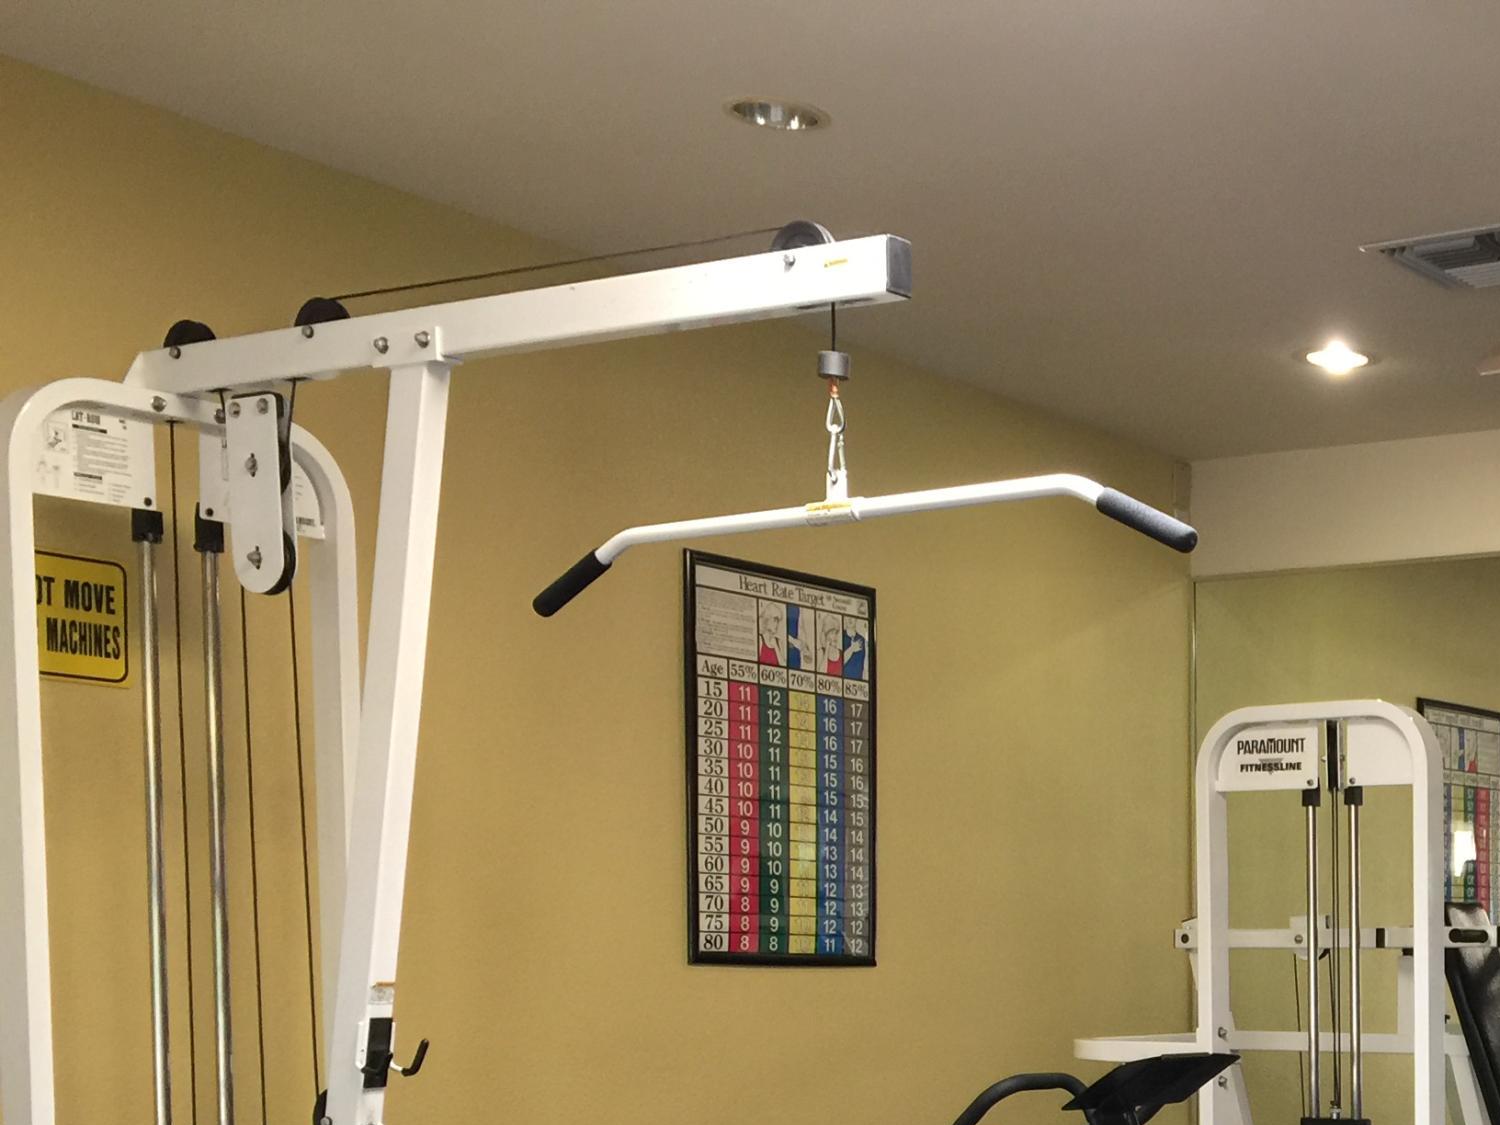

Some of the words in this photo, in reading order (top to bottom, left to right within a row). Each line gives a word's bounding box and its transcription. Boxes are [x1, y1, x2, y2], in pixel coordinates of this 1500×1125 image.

[64, 579, 116, 615] MOVE
[739, 575, 767, 595] Heart
[771, 582, 794, 600] Rate
[795, 587, 825, 608] Target
[46, 617, 121, 660] MACHINES
[702, 659, 723, 677] Age
[730, 661, 756, 679] 55%
[761, 668, 786, 685] 60%
[790, 673, 814, 688] 70%
[817, 678, 841, 694] 80%
[845, 683, 868, 698] 85%
[704, 680, 722, 696] 15
[738, 686, 750, 700] 11
[767, 691, 781, 706] 12
[824, 699, 837, 714] 16
[851, 704, 862, 718] 17
[704, 700, 722, 717] 20
[739, 706, 750, 720] 11
[768, 710, 781, 725] 12
[824, 718, 837, 732] 16
[850, 722, 862, 736] 17
[704, 720, 723, 736] 25
[739, 726, 751, 740] 11
[768, 729, 781, 744] 12
[824, 736, 837, 750] 16
[850, 741, 863, 754] 17
[1237, 737, 1306, 755] PARAMOUNT
[704, 739, 722, 756] 30
[737, 744, 752, 759] 10
[769, 748, 780, 762] 11
[824, 755, 837, 769] 15
[851, 758, 863, 772] 16
[1240, 762, 1302, 773] FITNESSLINE
[704, 759, 723, 776] 35
[737, 763, 752, 778] 10
[769, 766, 780, 781] 11
[824, 773, 837, 788] 15
[851, 776, 863, 790] 16
[704, 779, 723, 794] 40
[738, 782, 753, 797] 10
[769, 785, 780, 800] 11
[824, 791, 837, 806] 15
[851, 794, 864, 808] 15
[704, 798, 723, 814] 45
[738, 801, 753, 816] 10
[769, 804, 780, 819] 11
[824, 810, 837, 824] 14
[851, 813, 864, 827] 15
[704, 817, 723, 833] 50
[740, 820, 749, 835] 9
[767, 823, 782, 838] 10
[824, 828, 837, 842] 14
[851, 831, 863, 844] 14
[704, 837, 723, 852] 55
[740, 839, 749, 854] 9
[767, 842, 782, 857] 10
[824, 846, 837, 861] 13
[851, 849, 863, 862] 14
[704, 856, 723, 872] 60
[740, 858, 749, 873] 9
[767, 861, 782, 875] 10
[824, 864, 837, 879] 13
[851, 867, 863, 881] 14
[704, 876, 723, 891] 65
[740, 878, 749, 893] 9
[770, 879, 779, 894] 9
[824, 883, 837, 897] 12
[851, 884, 863, 898] 13
[705, 896, 723, 911] 70
[740, 897, 750, 912] 8
[770, 898, 779, 913] 9
[824, 901, 836, 916] 12
[851, 902, 863, 917] 13
[705, 915, 723, 930] 75
[740, 916, 750, 931] 8
[770, 917, 779, 932] 9
[824, 920, 836, 934] 12
[851, 921, 863, 935] 12
[703, 935, 723, 950] 80
[740, 936, 750, 950] 8
[769, 936, 778, 950] 8
[824, 937, 835, 951] 11
[851, 939, 863, 953] 12
